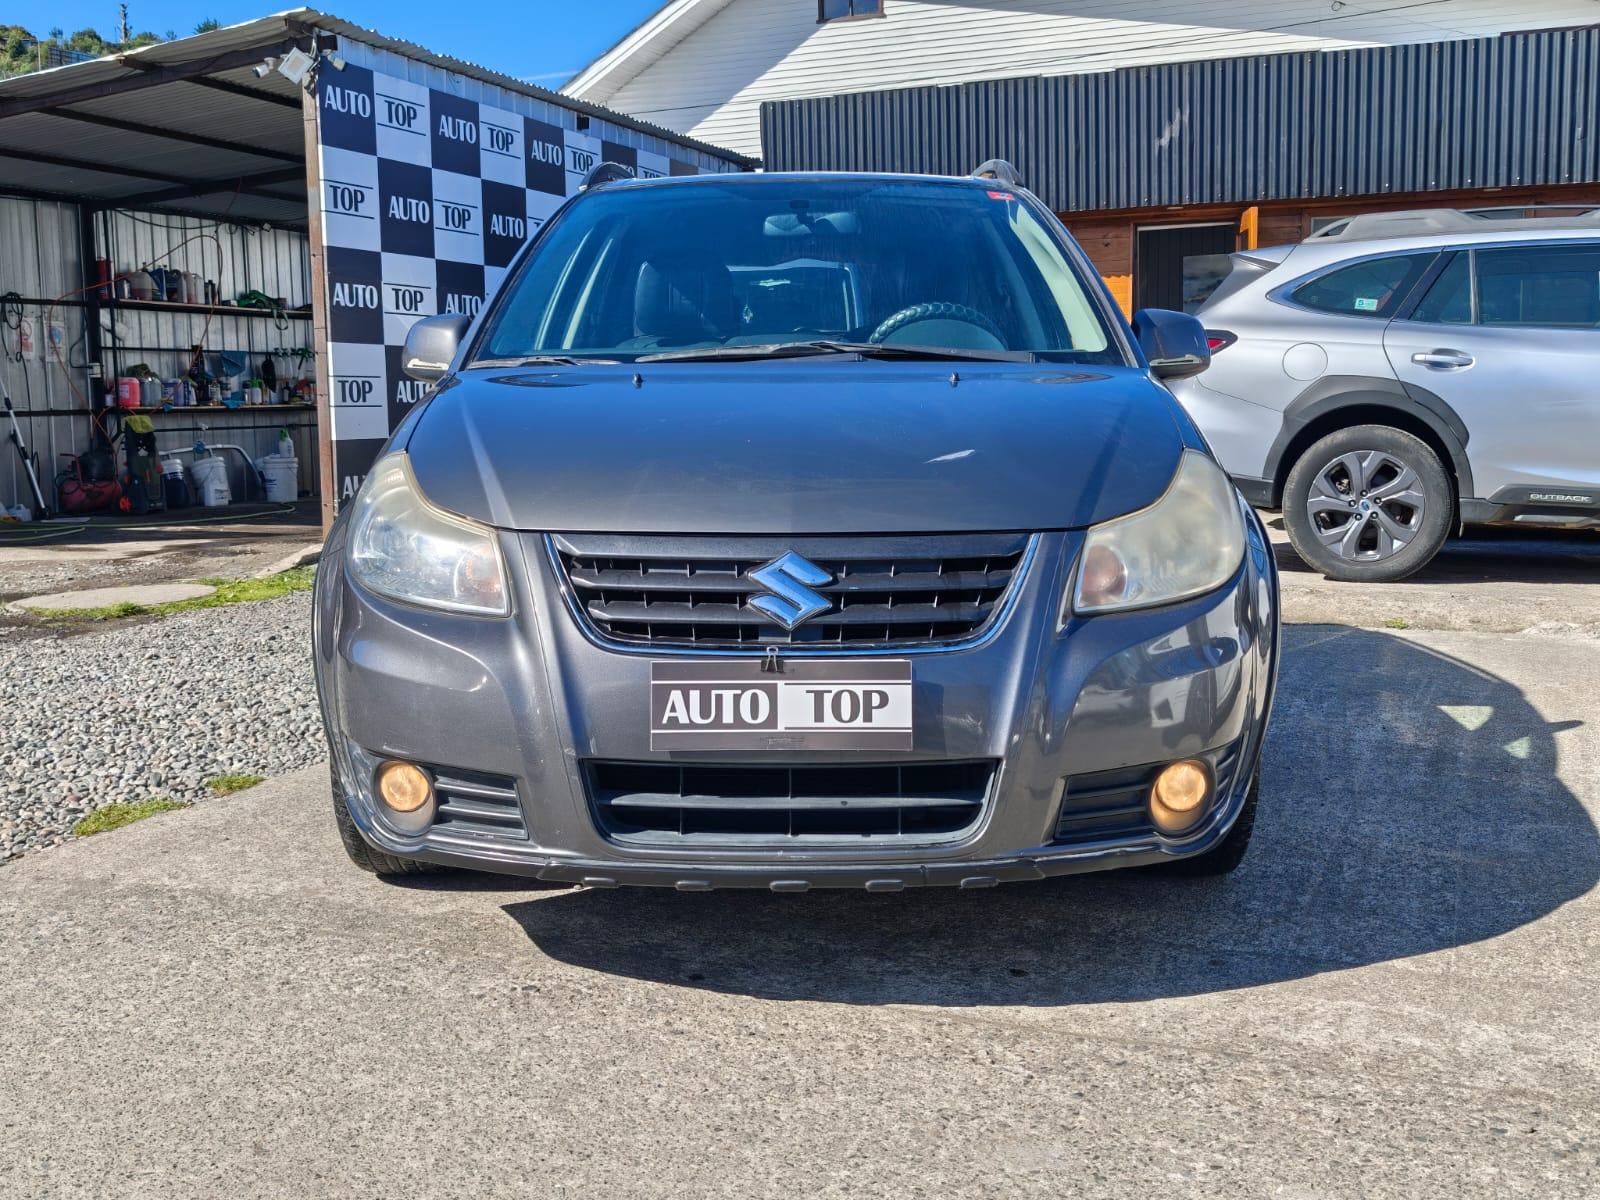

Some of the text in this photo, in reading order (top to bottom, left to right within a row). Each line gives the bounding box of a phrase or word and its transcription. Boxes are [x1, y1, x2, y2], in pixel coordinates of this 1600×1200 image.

[325, 84, 371, 118] AUTO
[384, 99, 418, 128] TOP
[439, 114, 477, 144] AUTO
[487, 127, 514, 152] TOP
[531, 140, 562, 166] AUTO
[571, 150, 593, 172] TOP
[329, 184, 525, 239] TOP AUTO TOP AUTO
[333, 282, 482, 316] AUTO TOP AUTO
[337, 380, 373, 403] TOP
[1530, 493, 1592, 503] OUTBACK
[661, 688, 890, 724] AUTO TOP
